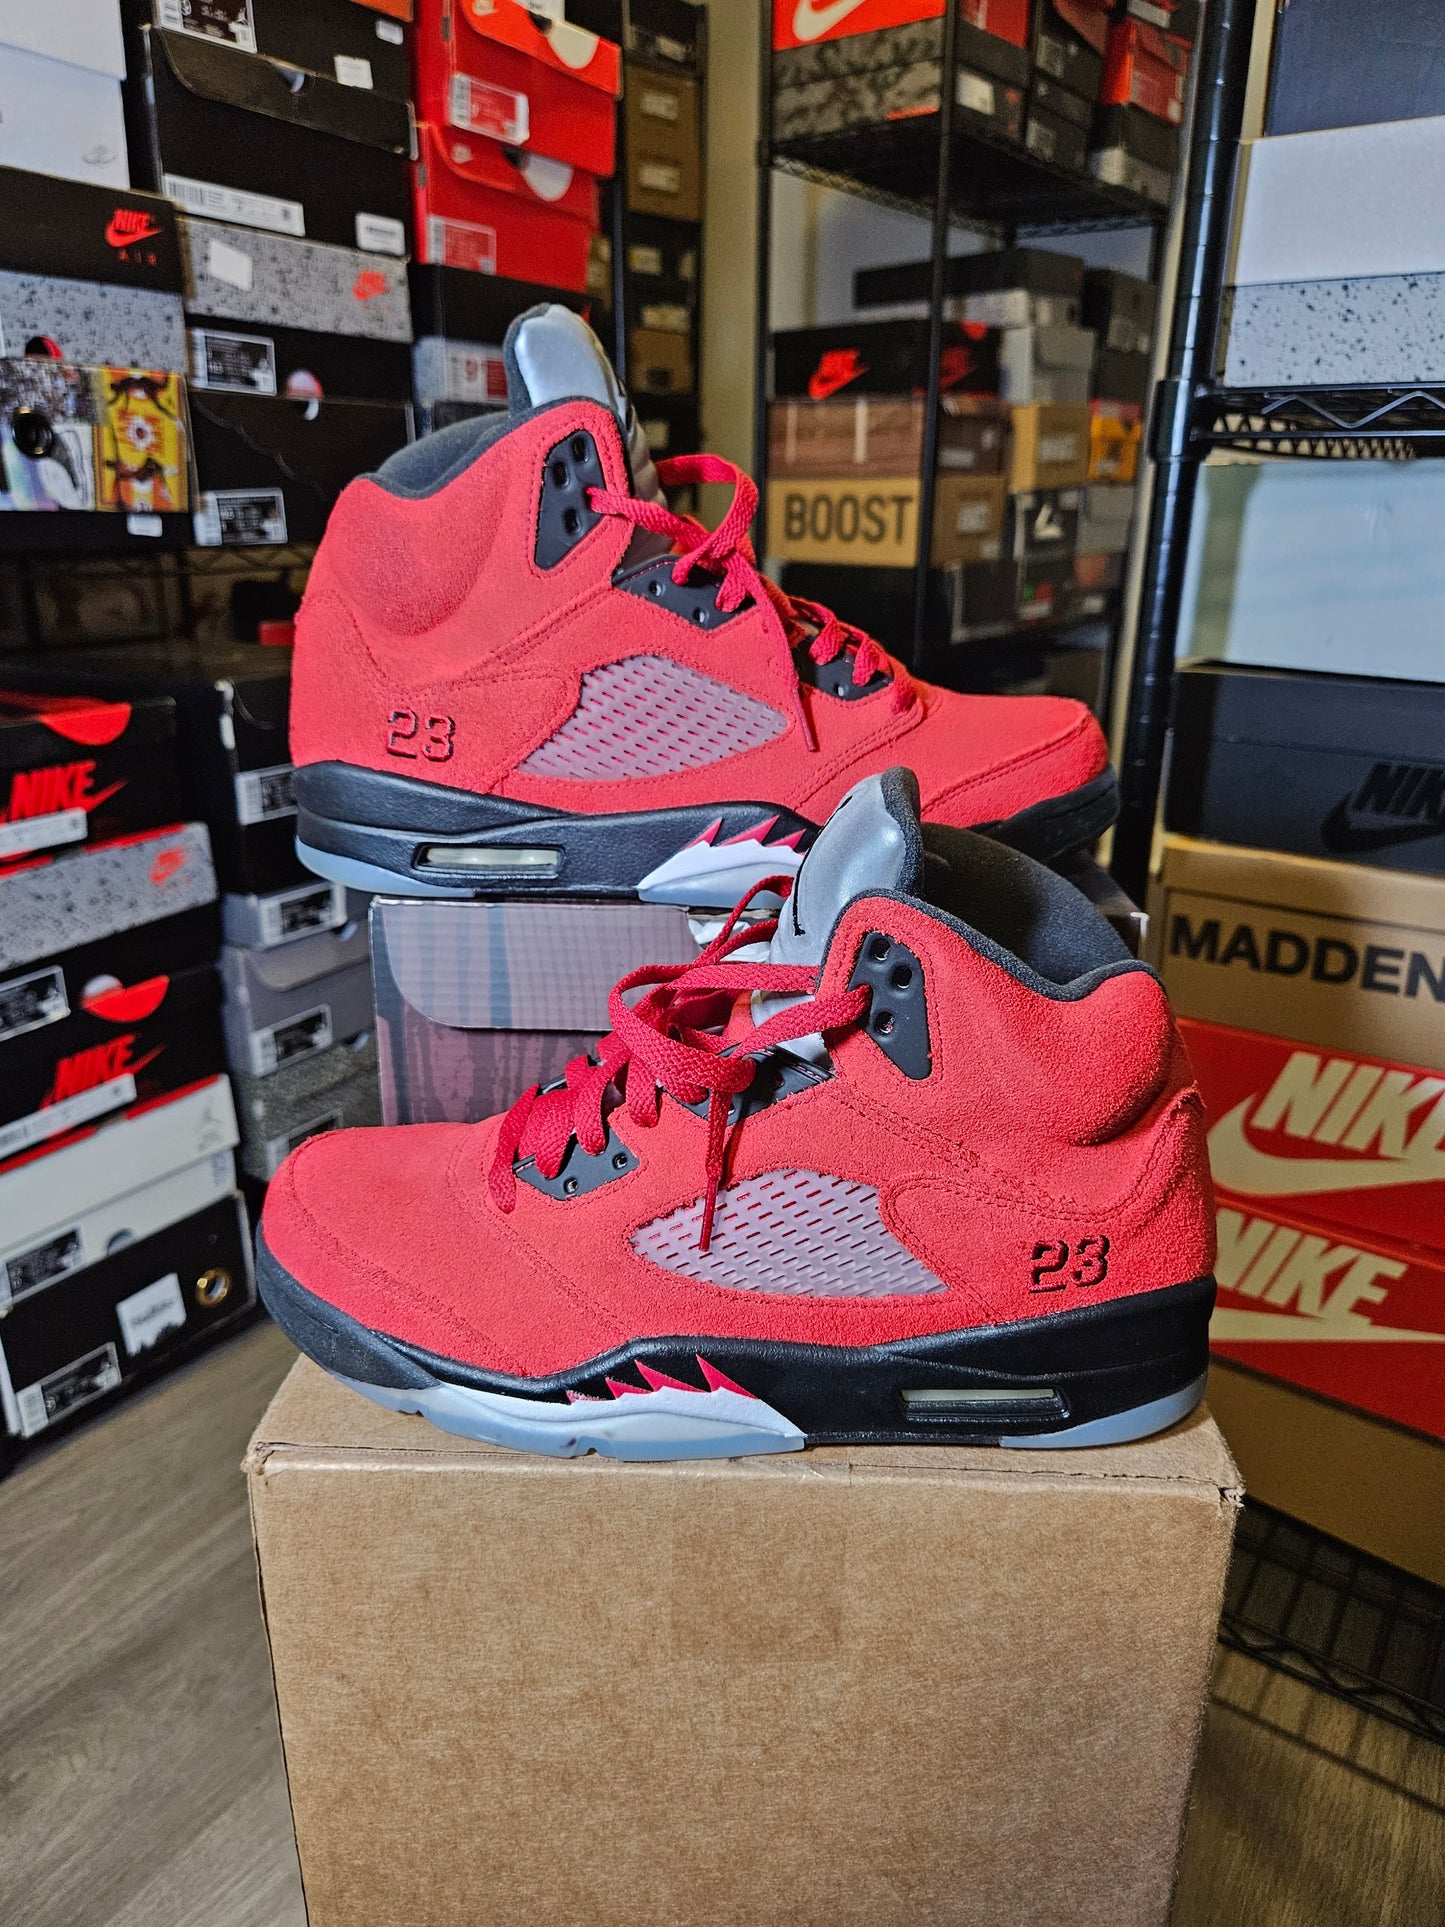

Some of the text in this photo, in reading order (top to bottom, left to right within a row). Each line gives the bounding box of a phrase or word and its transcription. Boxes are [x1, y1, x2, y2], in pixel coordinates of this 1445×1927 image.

[783, 492, 914, 544] BOOST
[386, 706, 456, 762] 23
[10, 759, 97, 822] NIKE
[1171, 914, 1445, 1003] MADDEN
[1029, 1235, 1110, 1294] 23
